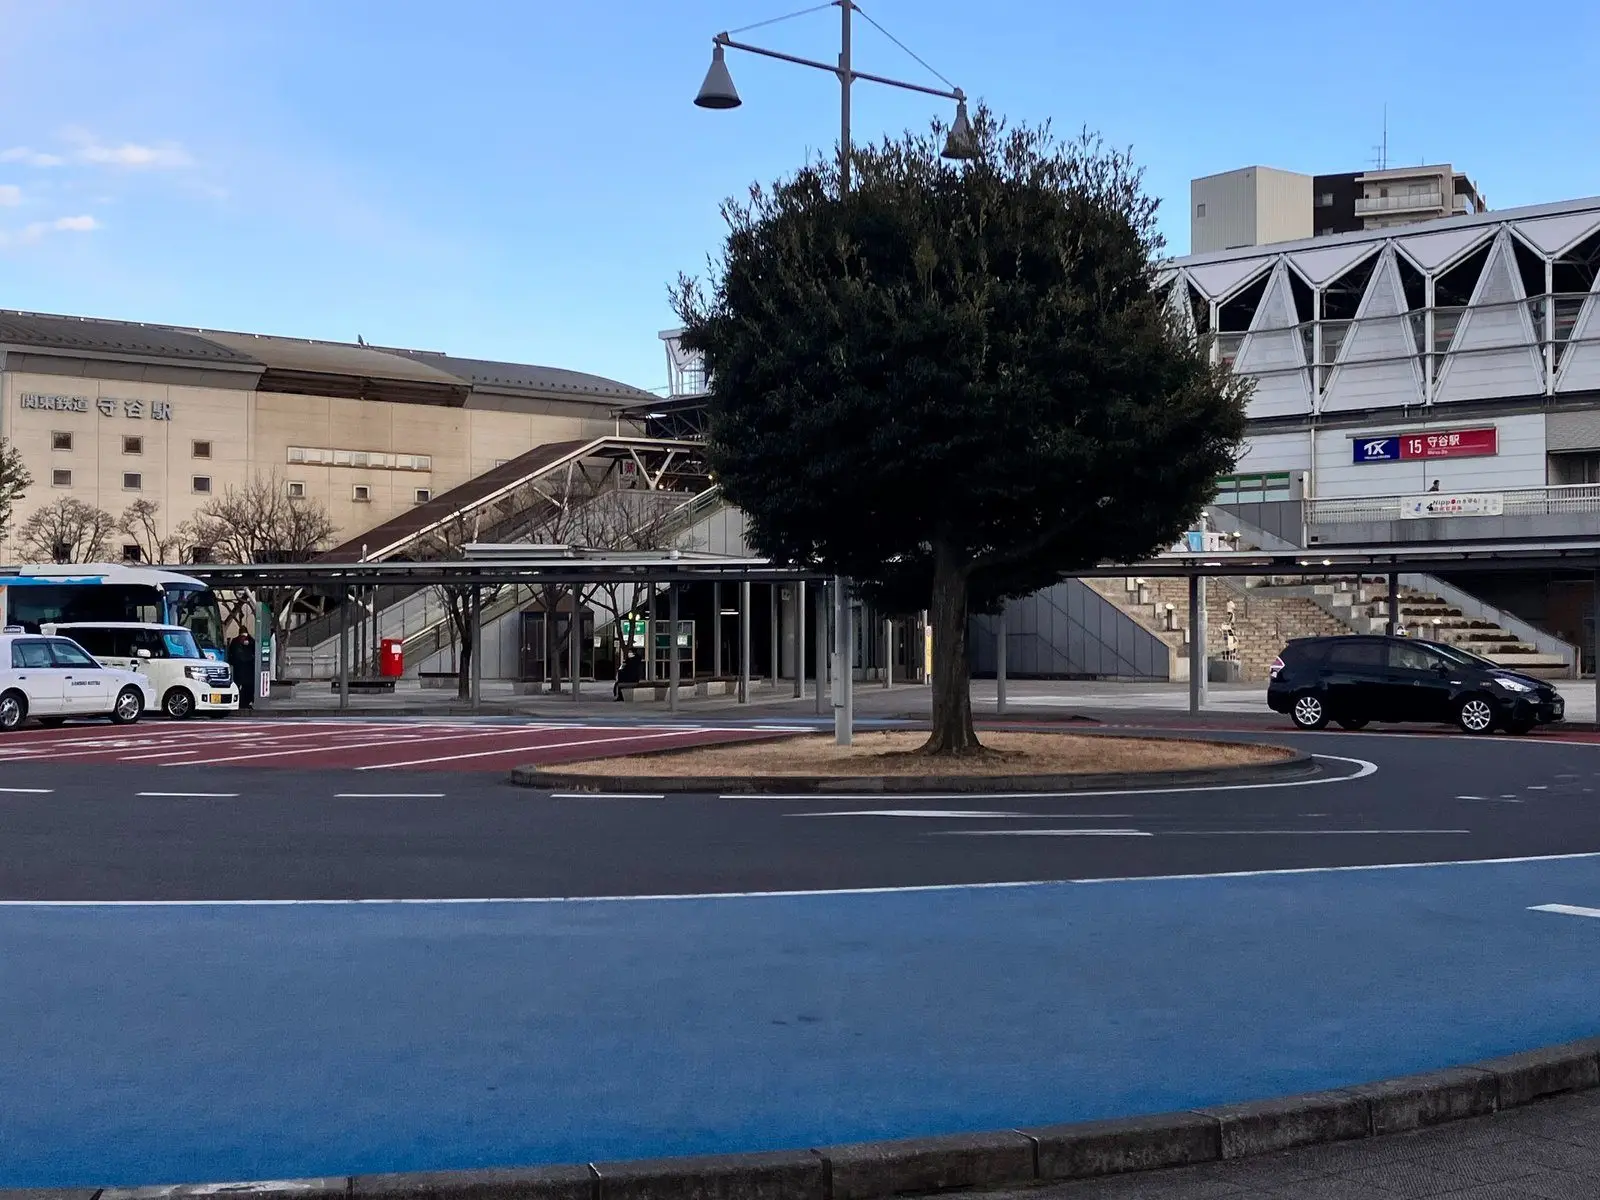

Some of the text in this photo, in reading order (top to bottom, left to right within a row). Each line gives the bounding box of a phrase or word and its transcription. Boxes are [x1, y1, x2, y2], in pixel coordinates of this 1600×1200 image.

[21, 393, 173, 420] 関東鉄道 守谷駅
[1409, 434, 1460, 454] 15 守谷駅
